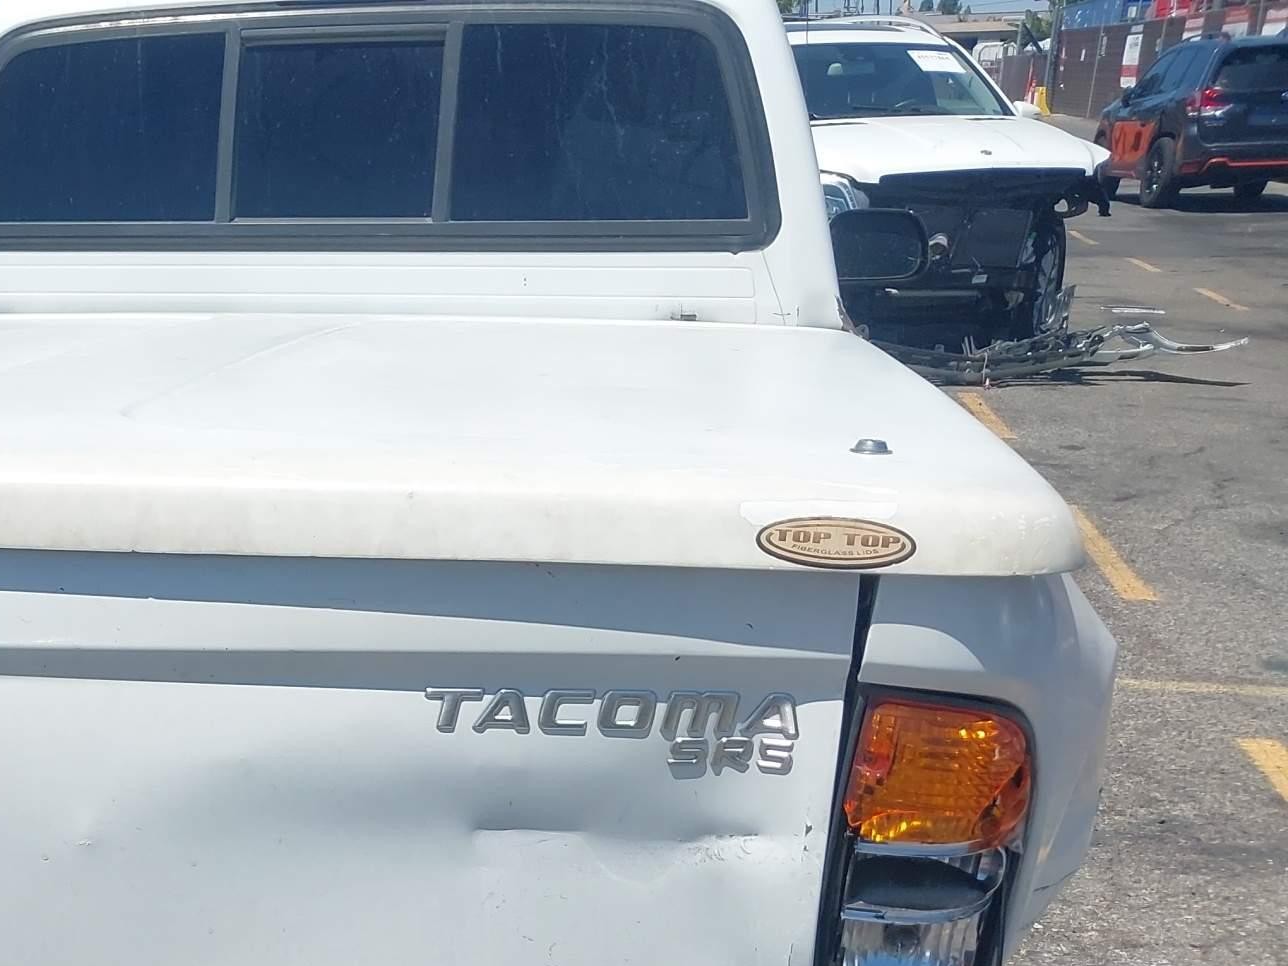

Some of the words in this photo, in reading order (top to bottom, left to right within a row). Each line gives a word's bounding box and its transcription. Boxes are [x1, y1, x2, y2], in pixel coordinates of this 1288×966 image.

[775, 528, 832, 544] TOP
[843, 532, 901, 549] TOP
[791, 543, 855, 556] FIBERGLASS
[424, 687, 800, 741] TACOMA
[667, 736, 795, 780] SRS
